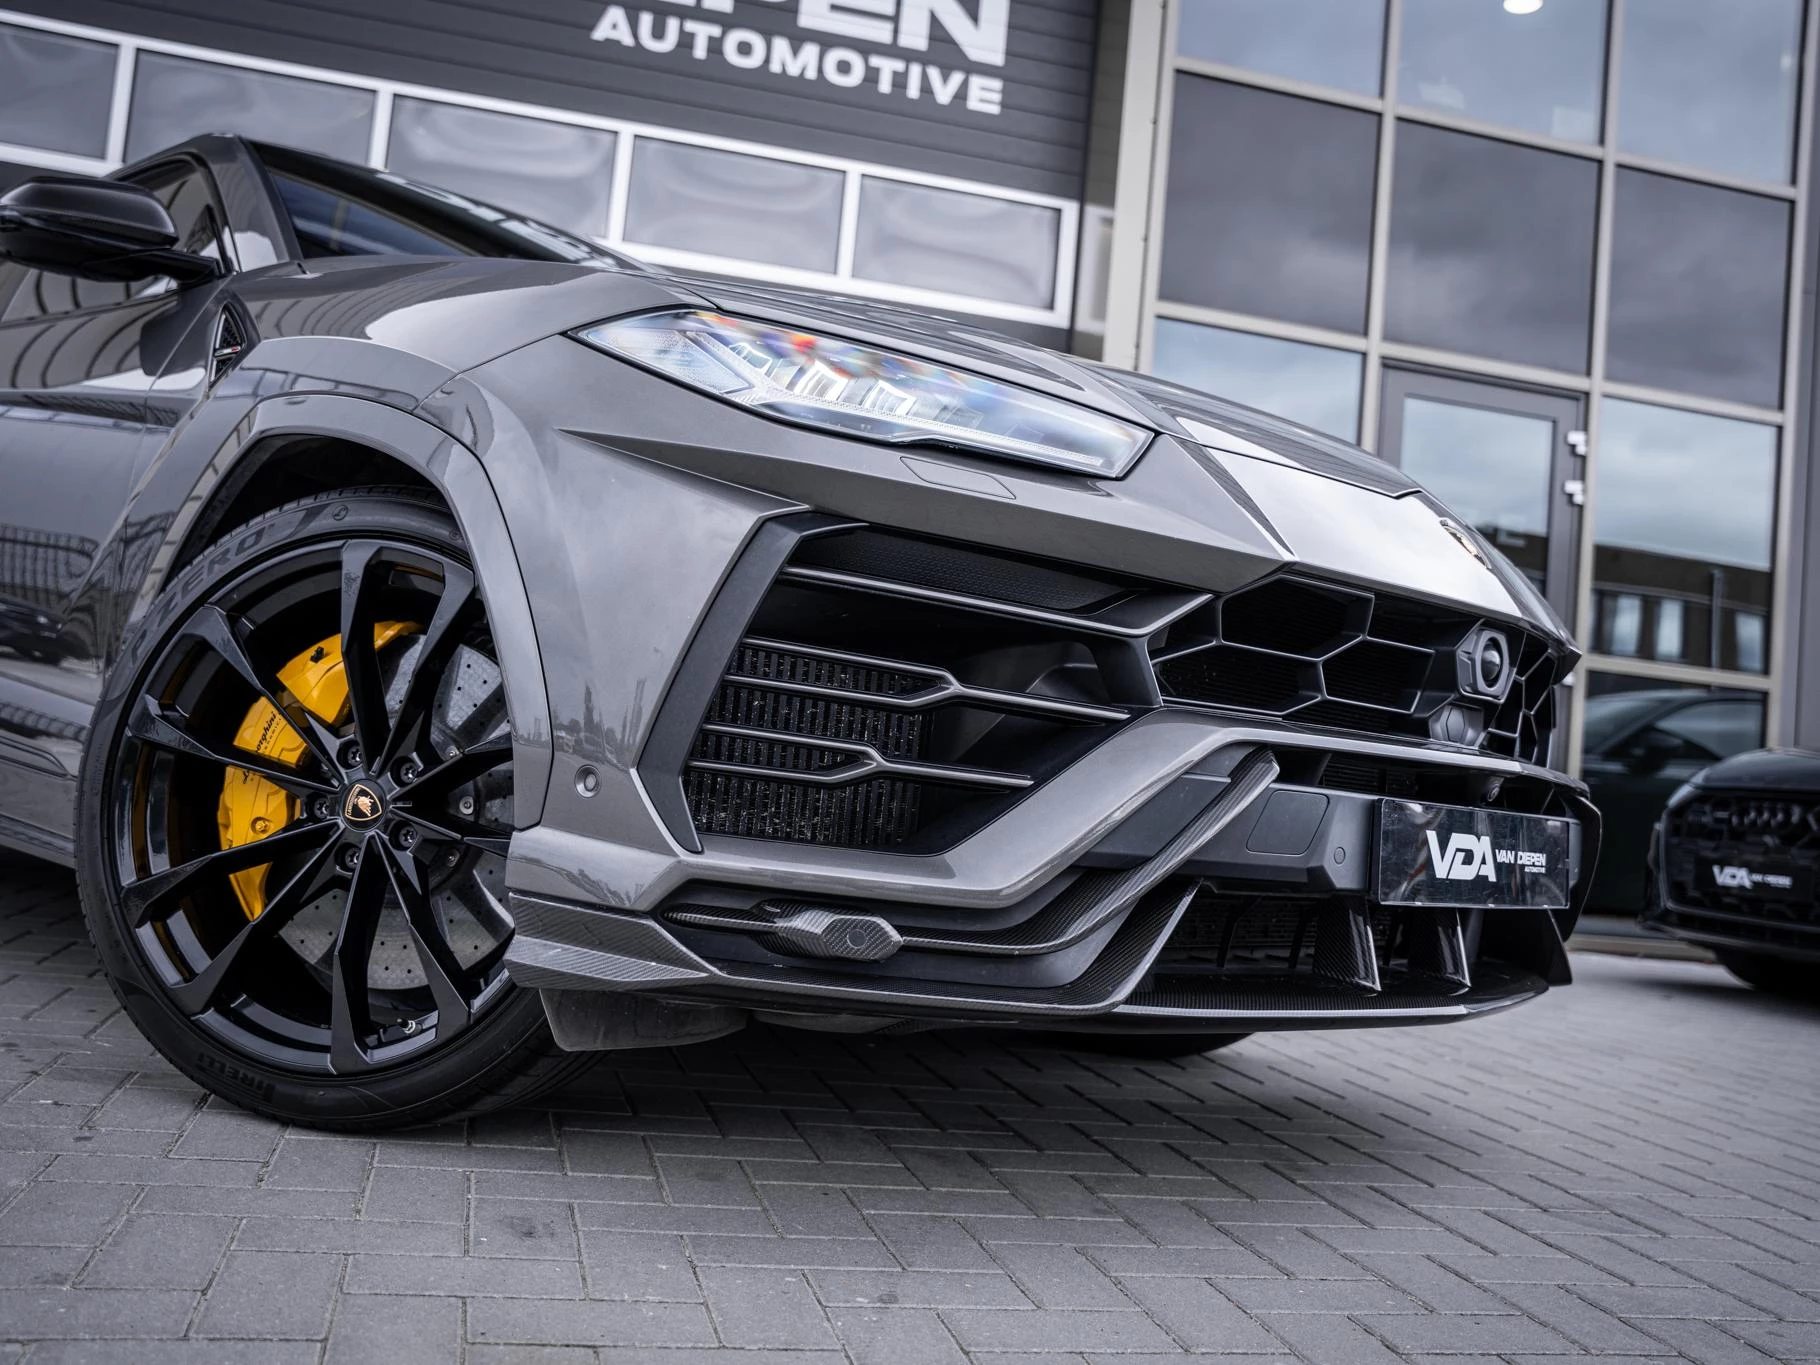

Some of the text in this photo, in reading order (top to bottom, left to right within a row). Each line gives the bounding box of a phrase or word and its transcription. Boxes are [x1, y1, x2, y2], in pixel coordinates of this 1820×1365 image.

[590, 5, 1004, 115] AUTOMOTIVE
[157, 525, 267, 629] ZERO
[1426, 829, 1497, 883] VDA
[1495, 849, 1546, 866] VAN DIEPEN
[1712, 864, 1753, 889] VDA
